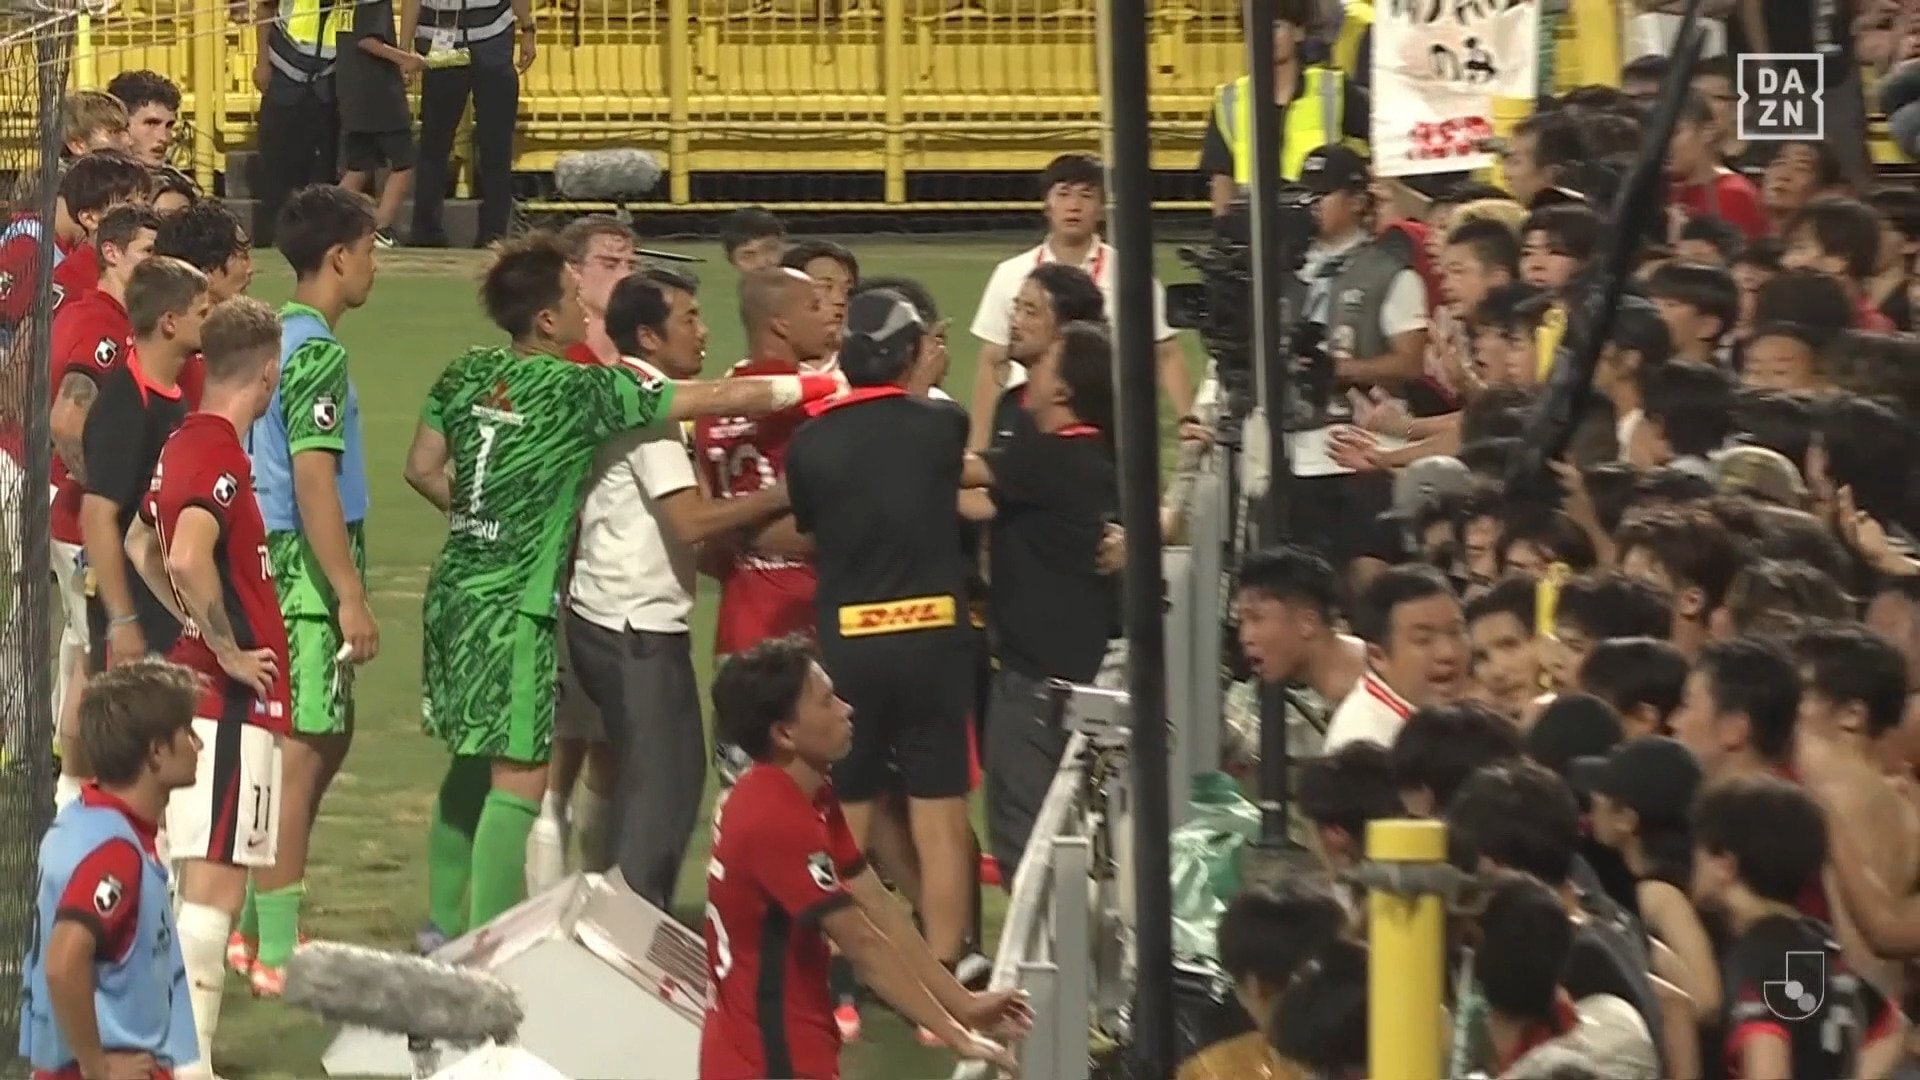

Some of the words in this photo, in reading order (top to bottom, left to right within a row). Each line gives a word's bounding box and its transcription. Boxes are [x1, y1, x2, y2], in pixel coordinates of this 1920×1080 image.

[472, 424, 496, 514] 1
[857, 603, 938, 628] DHL
[253, 784, 272, 833] 11
